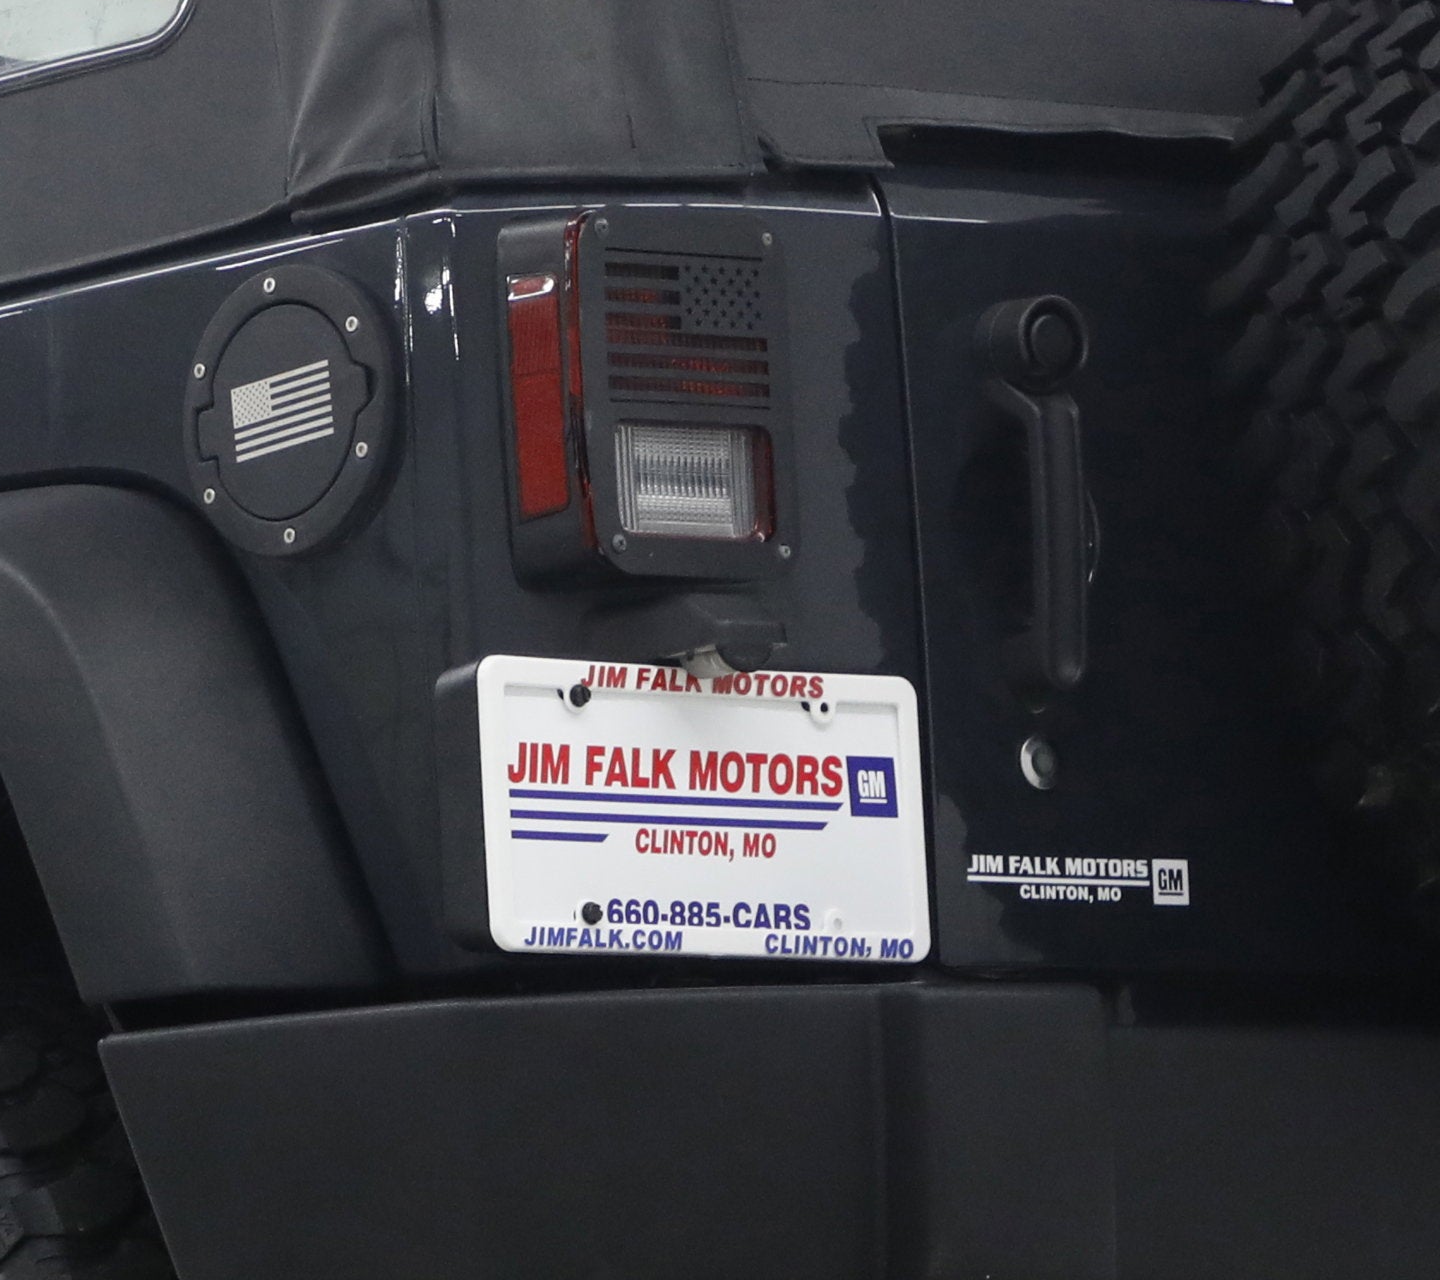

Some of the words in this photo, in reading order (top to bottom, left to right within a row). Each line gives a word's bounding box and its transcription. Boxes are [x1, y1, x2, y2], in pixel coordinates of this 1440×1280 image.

[581, 665, 627, 690] JIM
[636, 668, 702, 694] FALK
[712, 672, 824, 699] MOTORS
[507, 742, 571, 786] JIM
[585, 745, 677, 790] FALK
[688, 750, 844, 798] MOTORS
[856, 769, 887, 799] GM
[634, 827, 735, 863] CLINTON,
[741, 832, 777, 859] MO
[967, 854, 1004, 874] JIM
[1008, 856, 1061, 876] FALK
[1065, 858, 1148, 878] MOTORS
[1158, 868, 1184, 891] GM
[1020, 885, 1095, 904] CLINTON,
[1098, 887, 1122, 902] MO
[606, 898, 812, 931] 660-885-CARS
[524, 926, 684, 952] JIMFALK.COM
[764, 933, 873, 959] CLINTON,
[880, 938, 915, 960] MO
